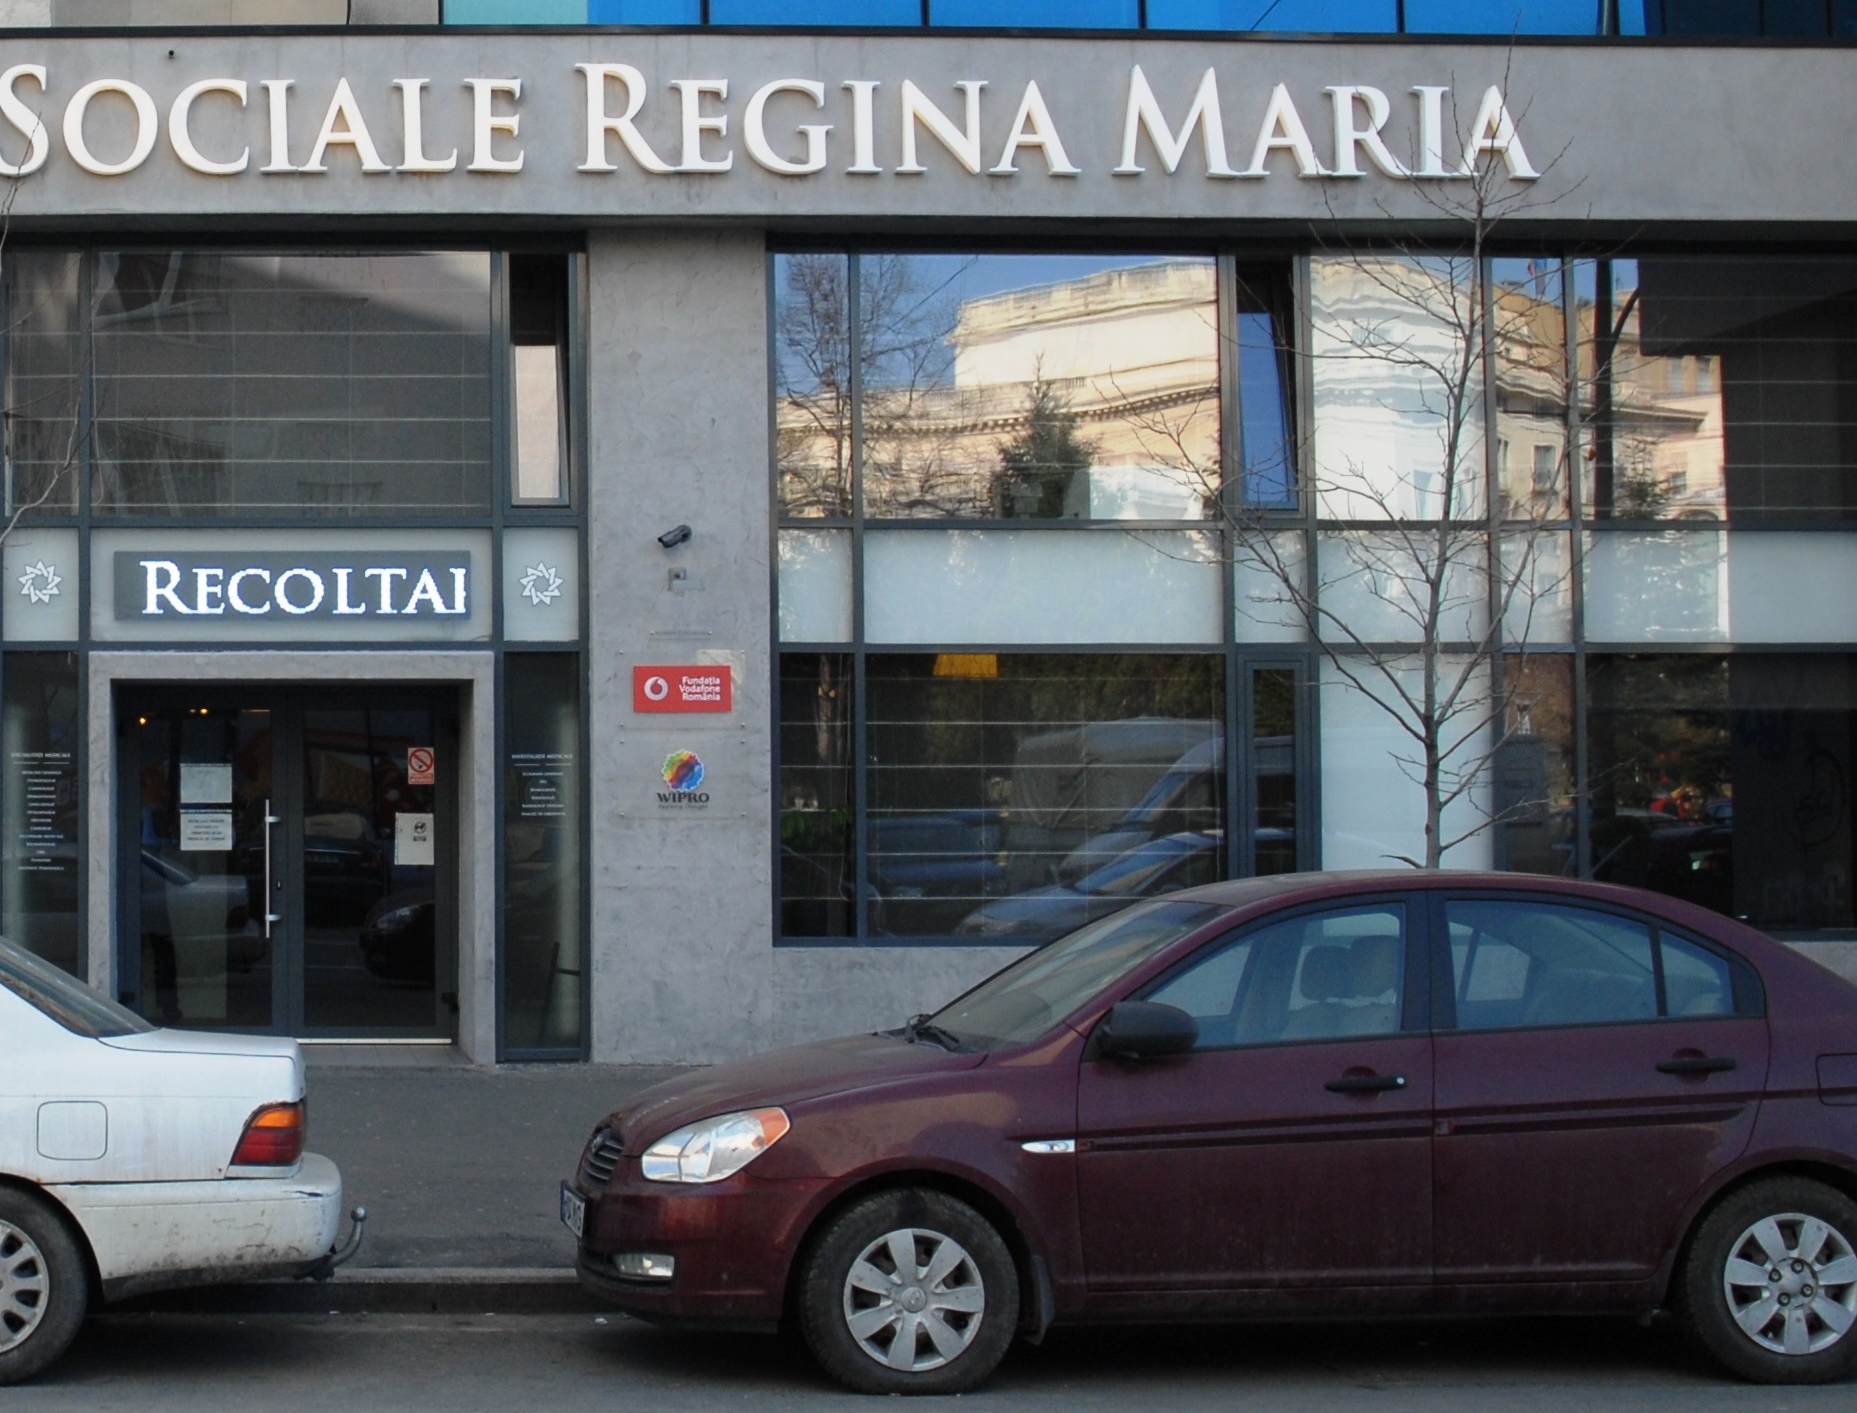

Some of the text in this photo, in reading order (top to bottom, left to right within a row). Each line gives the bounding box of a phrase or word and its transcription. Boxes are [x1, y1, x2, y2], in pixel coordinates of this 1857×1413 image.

[574, 62, 1082, 177] REGINA
[1113, 63, 1542, 181] MARIA
[678, 684, 720, 693] Vodafone
[656, 792, 710, 803] WIPRO
